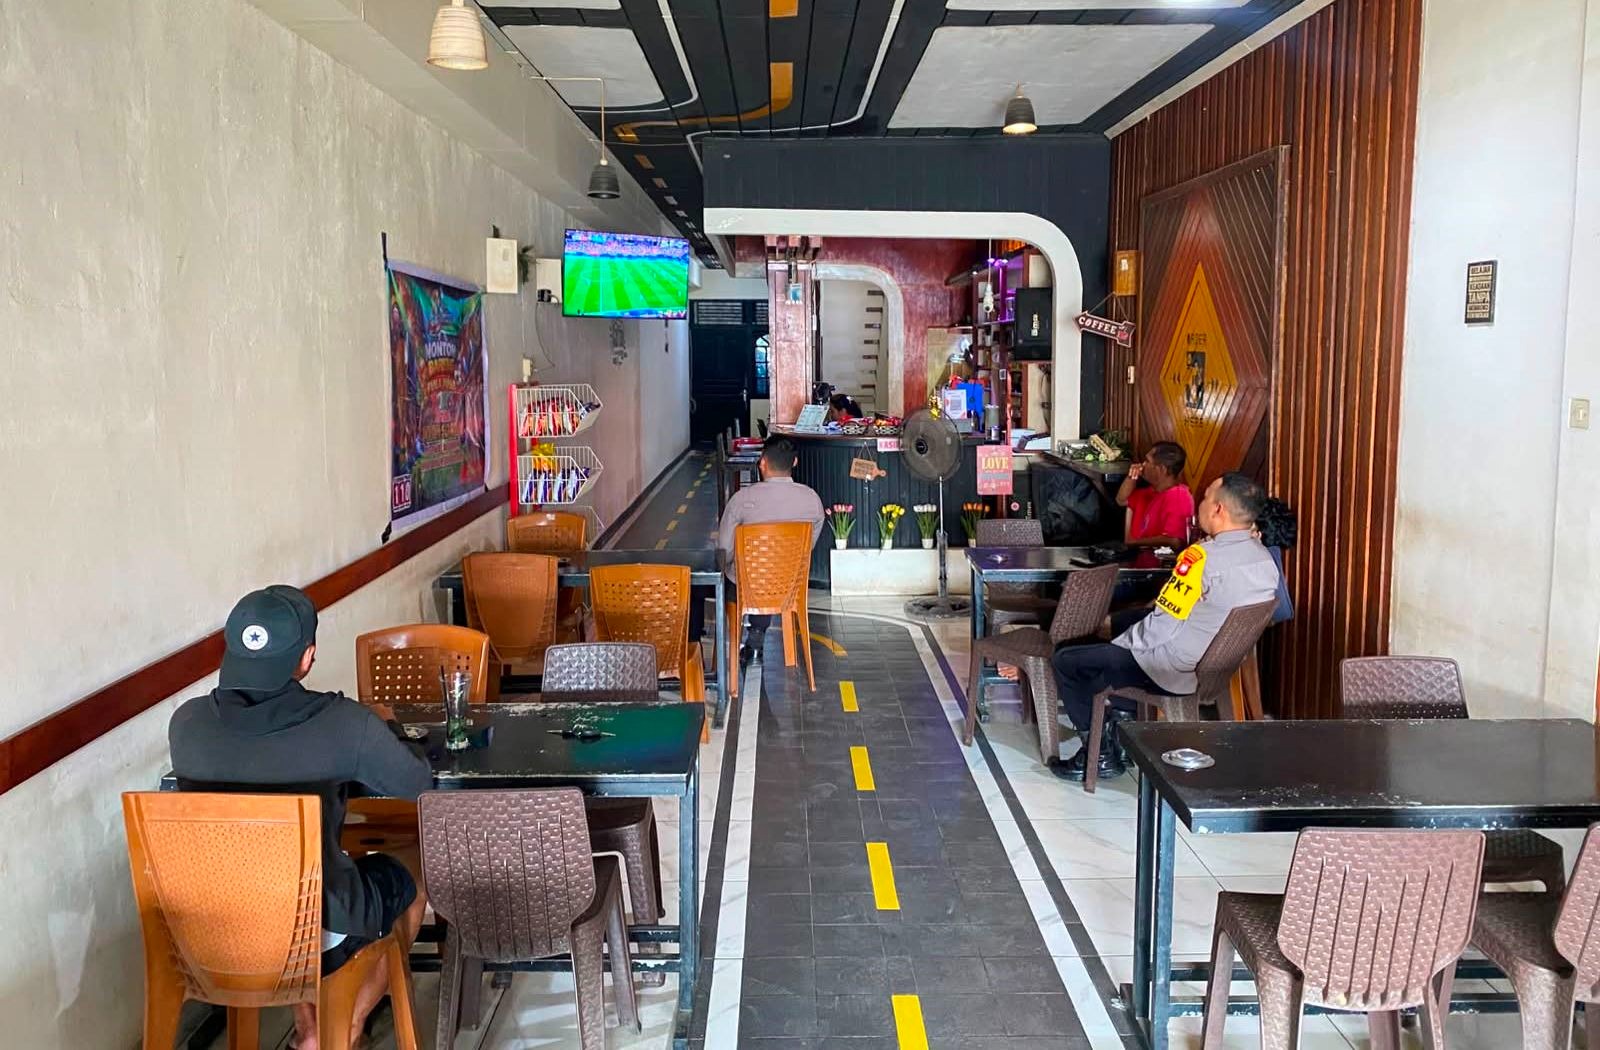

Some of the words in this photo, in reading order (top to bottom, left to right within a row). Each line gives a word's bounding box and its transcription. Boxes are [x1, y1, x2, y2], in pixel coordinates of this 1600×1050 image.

[1078, 316, 1117, 335] COFFEE
[981, 456, 1009, 470] LOVE
[394, 481, 411, 506] 110
